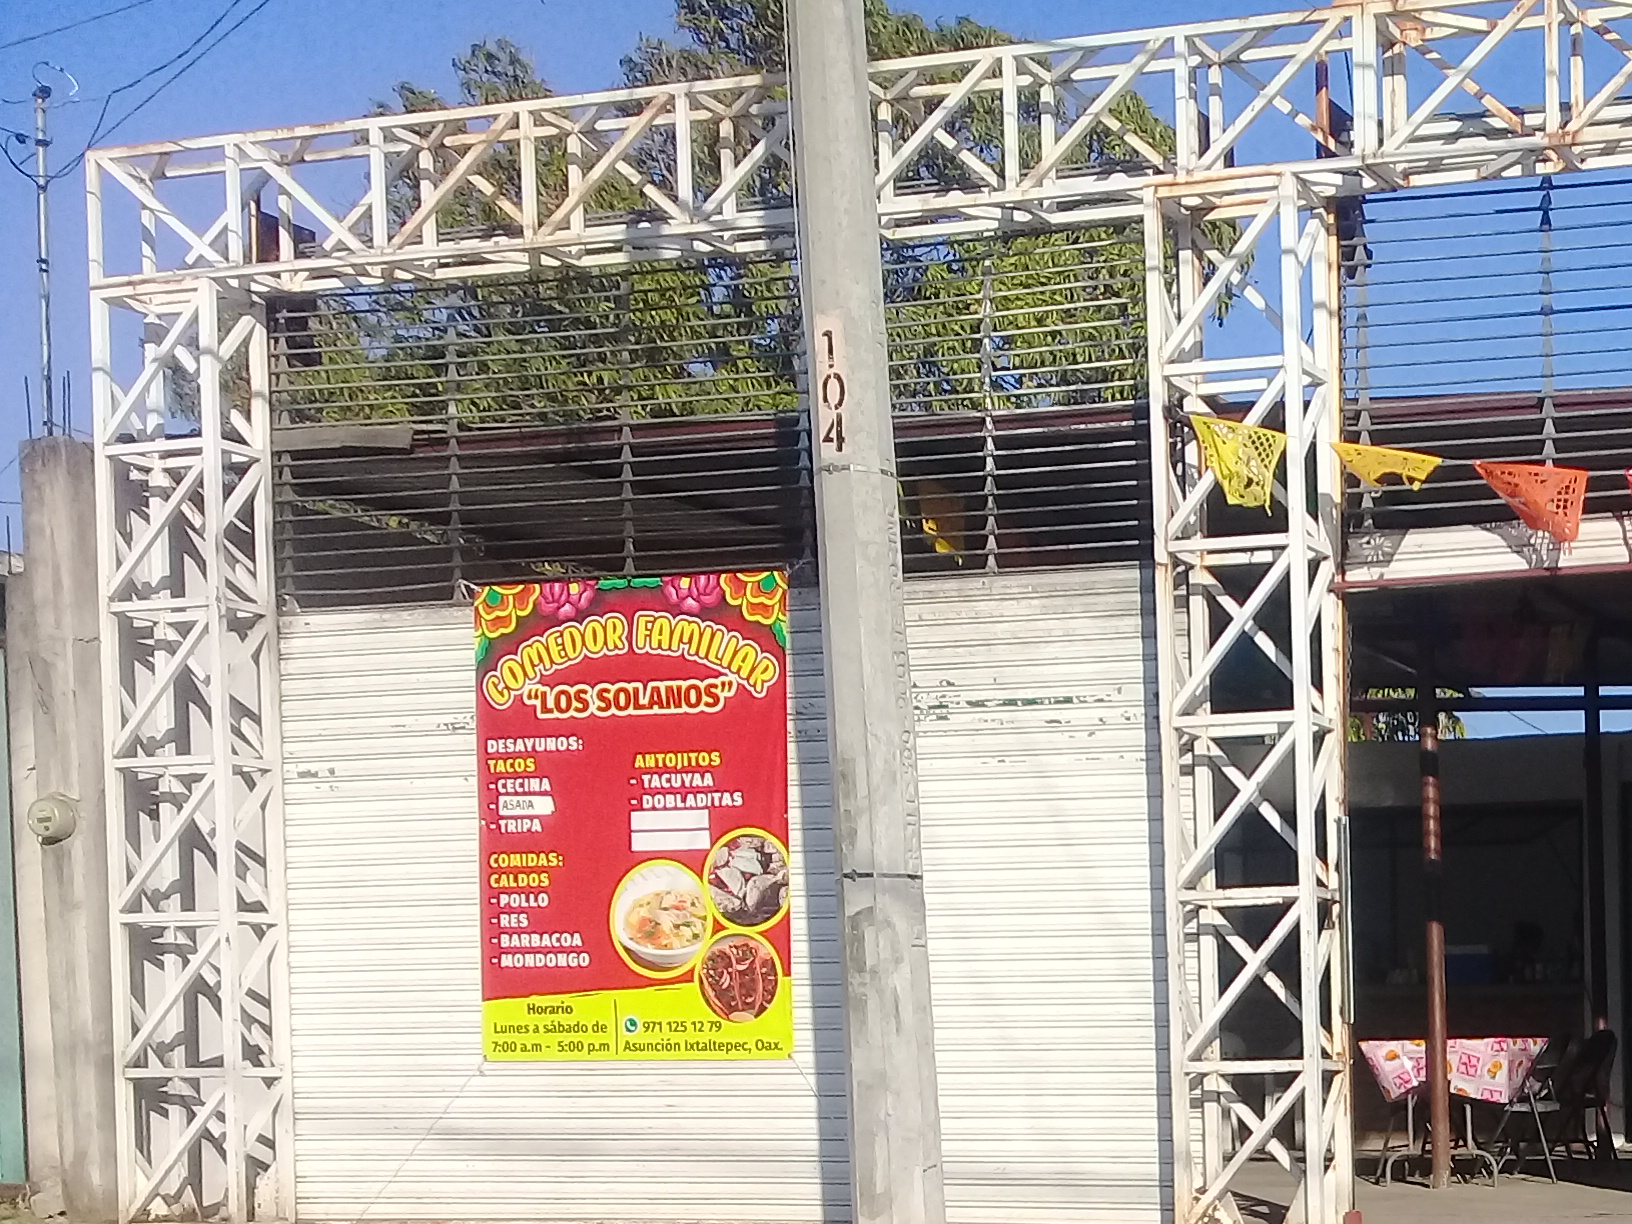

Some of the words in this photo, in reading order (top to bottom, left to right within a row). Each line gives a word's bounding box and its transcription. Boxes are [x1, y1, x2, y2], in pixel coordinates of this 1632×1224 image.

[822, 329, 846, 453] 104
[485, 614, 627, 708] COMEDOR
[635, 612, 777, 694] FAMILIAR
[486, 736, 584, 753] DESAYUNOS:
[487, 757, 536, 773] TACOS
[634, 752, 722, 768] ANTOJITOS
[642, 773, 714, 789] TACUYAA
[642, 791, 743, 809] DOBLADITAS
[489, 852, 564, 869] COMIDAS:
[489, 873, 550, 888] CALDOS
[527, 1002, 574, 1016] Horario
[493, 1021, 531, 1035] Lunes
[532, 1024, 541, 1035] a
[542, 1019, 589, 1035] sábado
[591, 1021, 609, 1035] de
[642, 1020, 664, 1034] 971
[667, 1020, 688, 1034] 125
[690, 1020, 705, 1034] 12
[707, 1020, 723, 1034] 79
[491, 1040, 519, 1054] 7:00
[520, 1042, 543, 1054] a.m
[557, 1040, 584, 1054] 5:00
[587, 1041, 610, 1056] p.m
[622, 1037, 682, 1054] Asunción
[754, 1037, 784, 1052] Oax.
